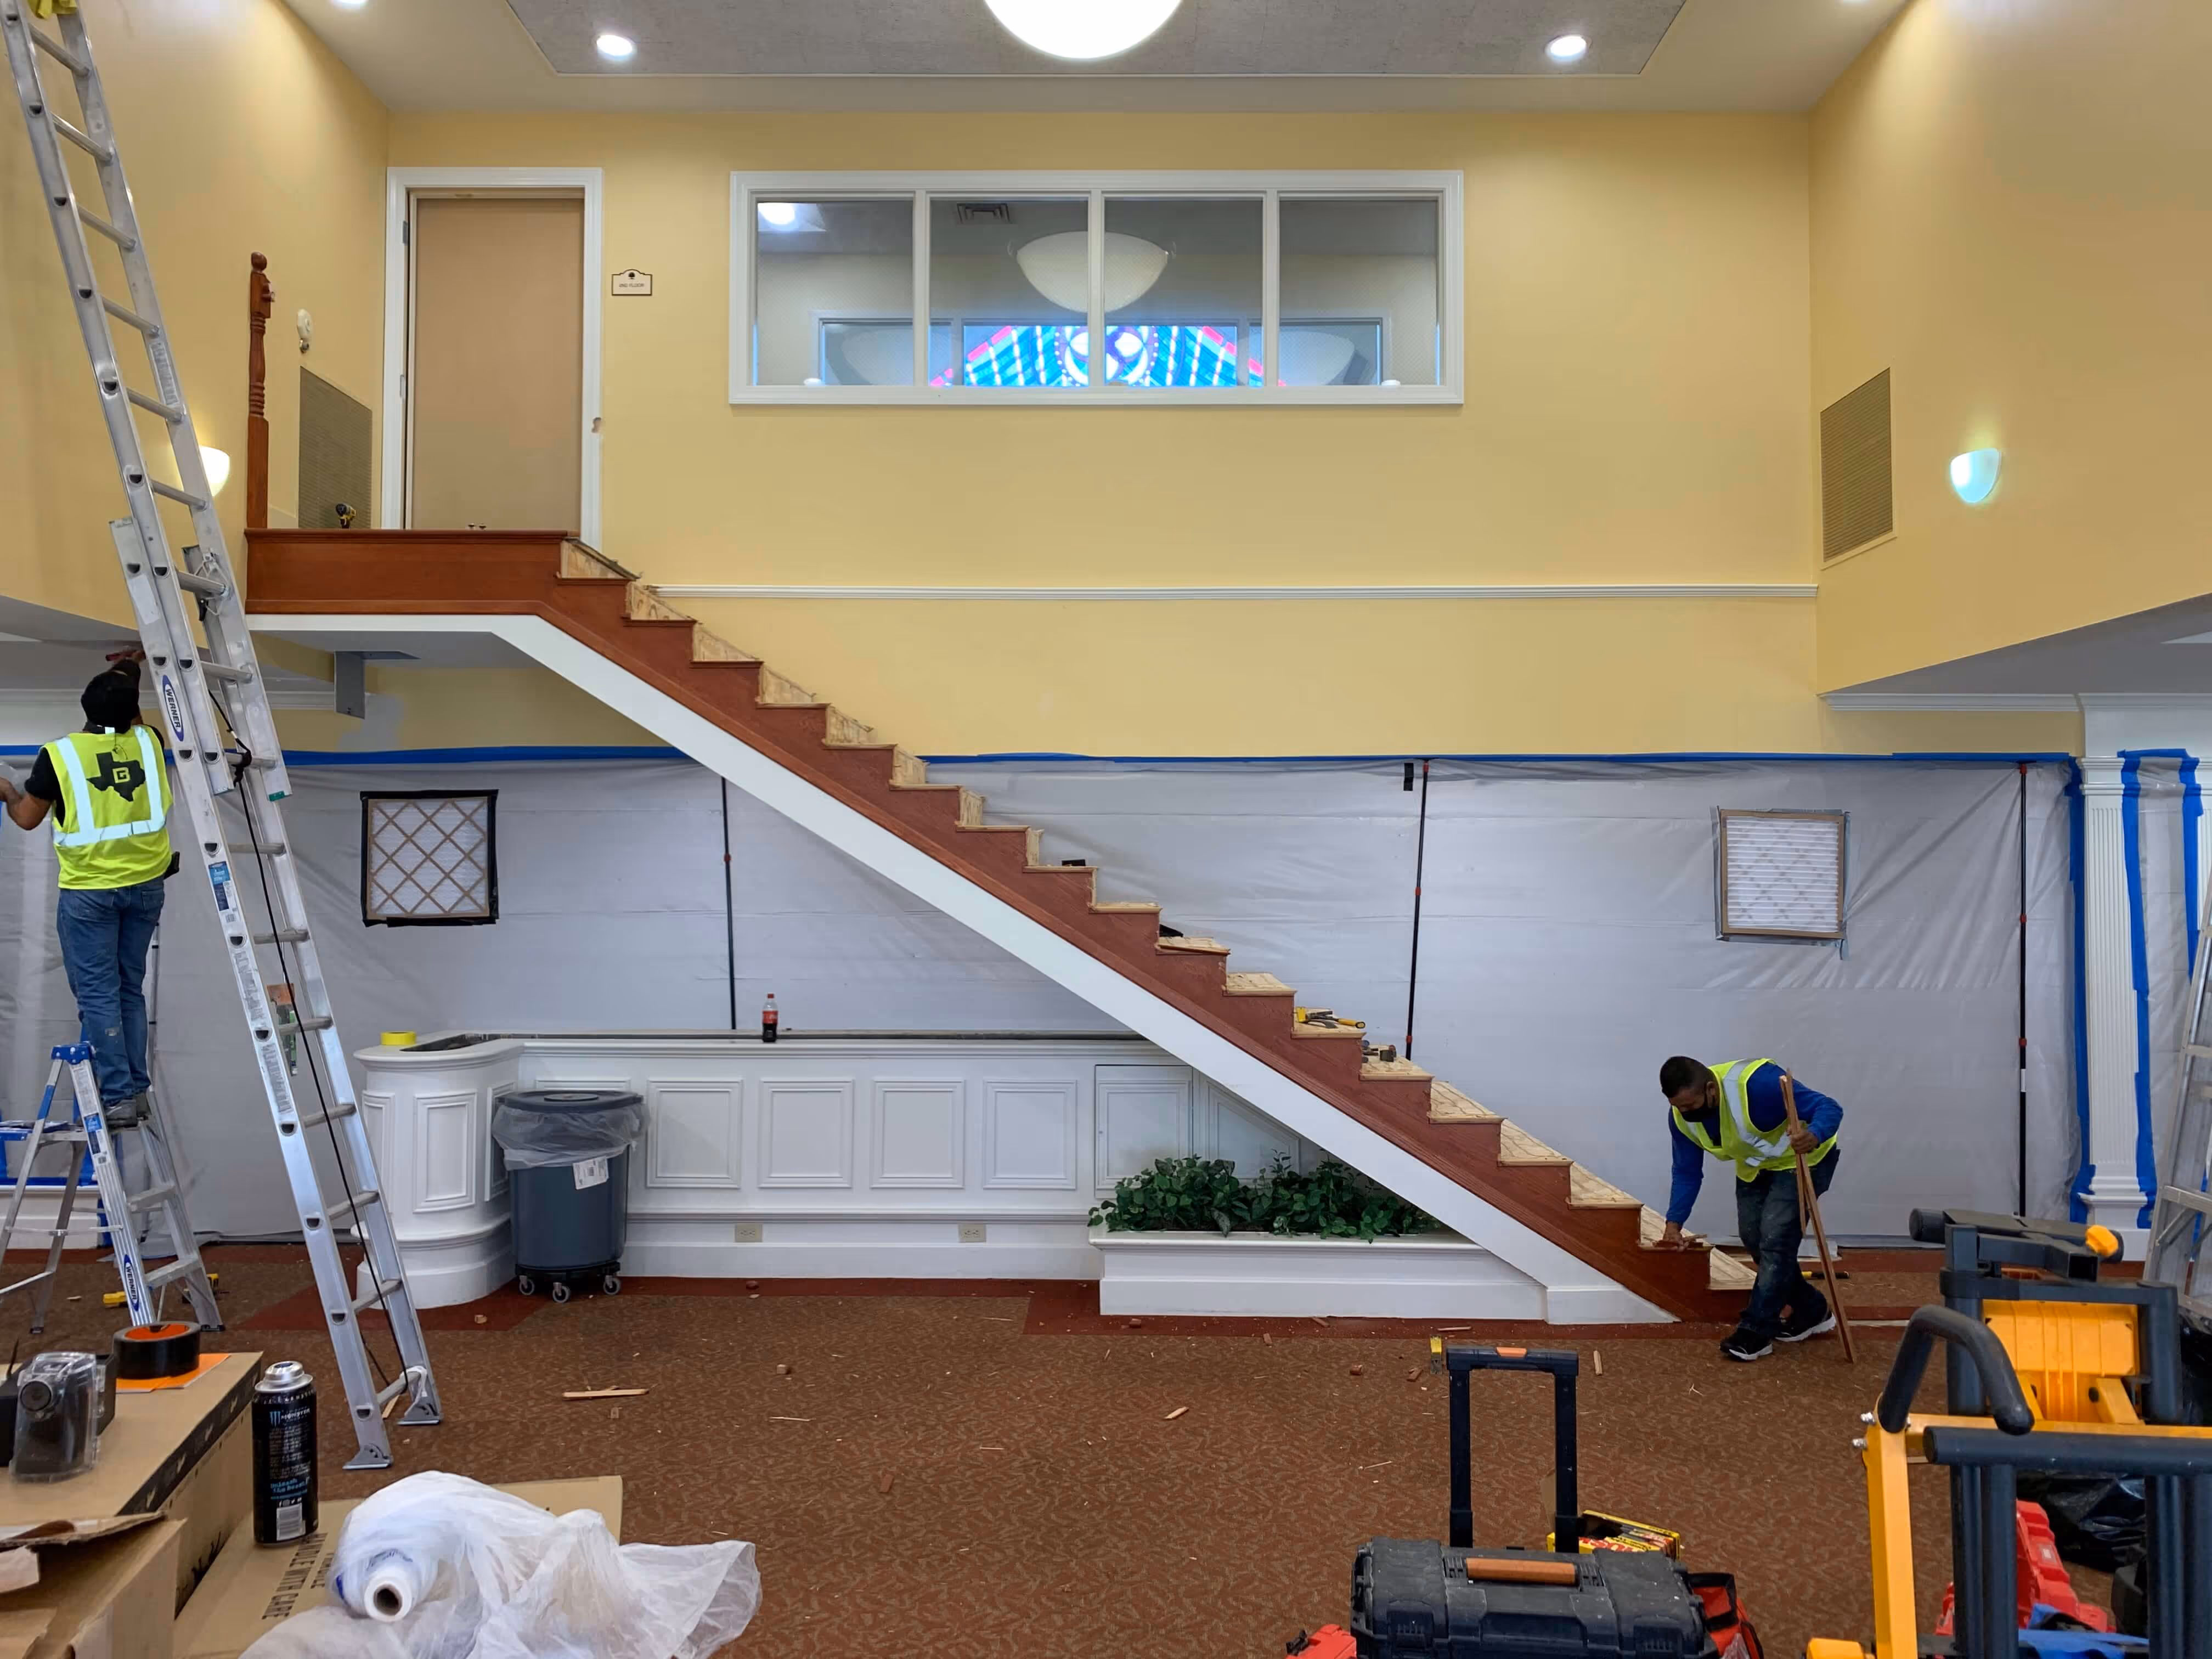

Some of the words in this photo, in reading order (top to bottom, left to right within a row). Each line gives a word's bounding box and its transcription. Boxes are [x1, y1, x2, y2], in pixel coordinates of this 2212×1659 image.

[166, 689, 181, 728] WERNER
[126, 1266, 137, 1300] WERNER
[281, 1408, 311, 1420] MONSTER
[261, 1593, 299, 1620] CARE
